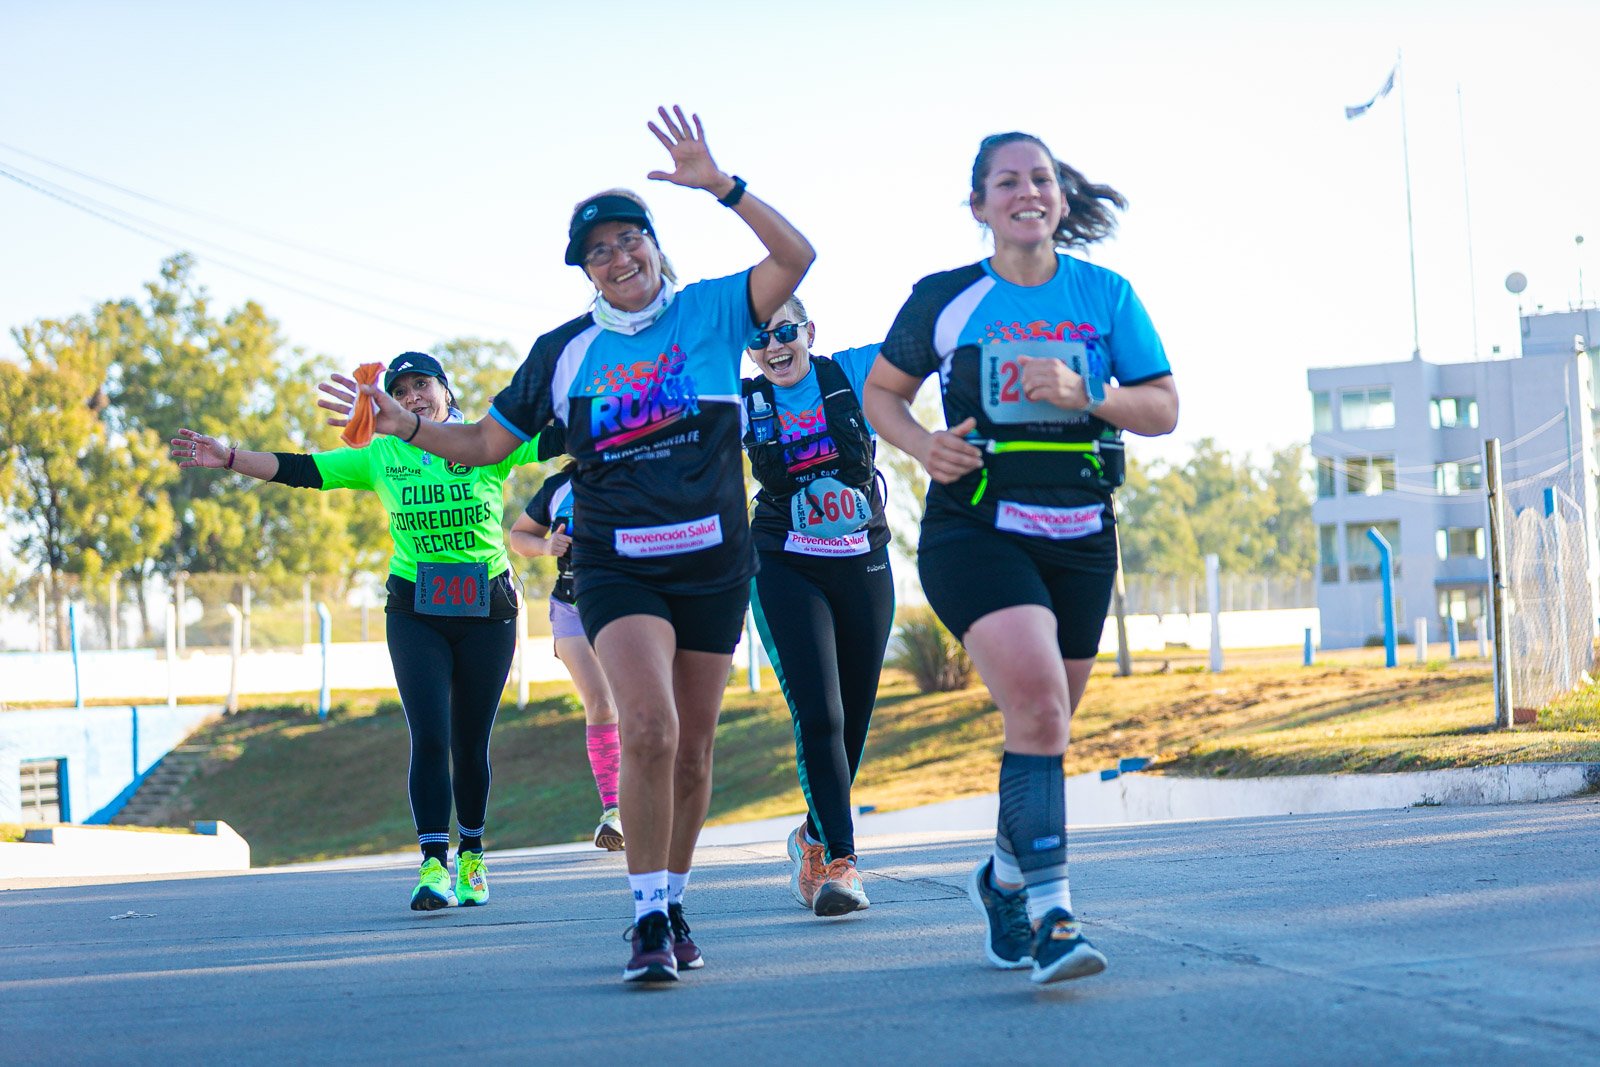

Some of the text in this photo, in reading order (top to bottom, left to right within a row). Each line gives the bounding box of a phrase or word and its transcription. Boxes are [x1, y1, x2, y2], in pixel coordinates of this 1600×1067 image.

[591, 378, 686, 438] RUN
[687, 430, 700, 443] FE
[385, 466, 422, 475] EMAPUR
[402, 483, 474, 505] CLUB DE
[391, 501, 491, 531] CORREDORES
[797, 493, 807, 529] TIEMPO
[805, 489, 856, 526] 260
[412, 531, 476, 554] RECREO
[621, 519, 717, 544] Prevención Salud
[792, 534, 865, 547] Prevención Salud
[432, 576, 478, 606] 240
